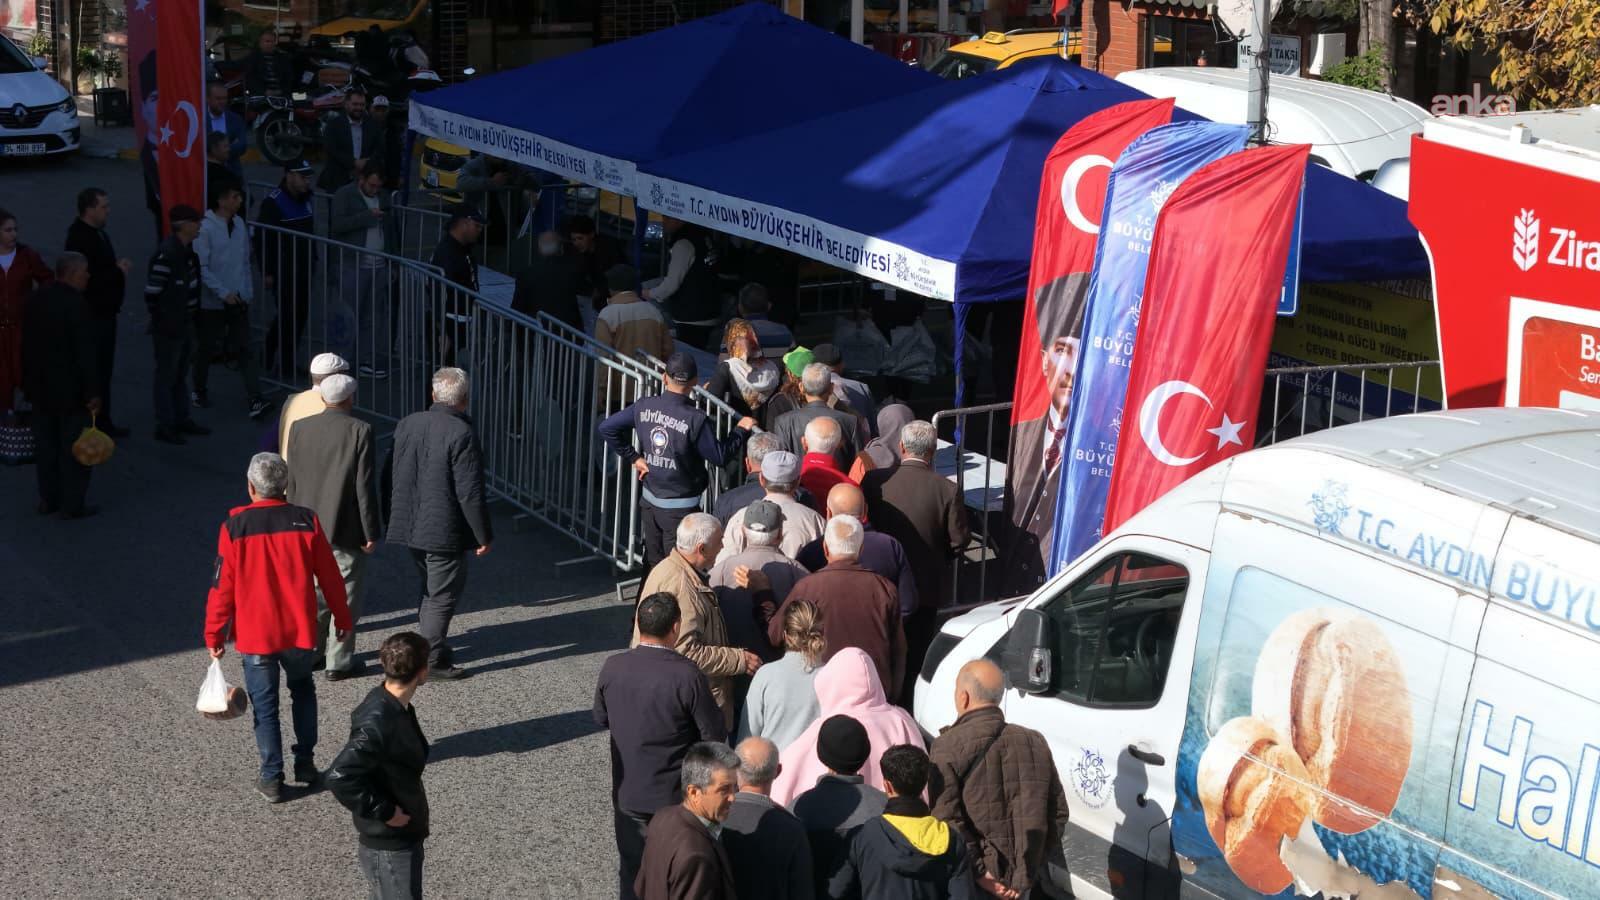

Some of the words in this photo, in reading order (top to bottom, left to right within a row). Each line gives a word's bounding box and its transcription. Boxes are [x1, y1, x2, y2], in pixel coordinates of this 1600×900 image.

[459, 124, 481, 142] AYDIN
[482, 126, 542, 159] BÜYÜKŞEHİR
[690, 197, 706, 216] T.C.
[708, 205, 740, 226] AYDIN
[741, 207, 824, 251] BÜYÜKŞEHİR
[826, 238, 891, 274] BELEDİYESİ
[1547, 226, 1600, 272] Zira
[1580, 333, 1600, 361] B
[640, 408, 689, 435] BÜYÜKŞEHİR
[1356, 509, 1398, 555] T.C.
[1406, 531, 1492, 590] AYDIN
